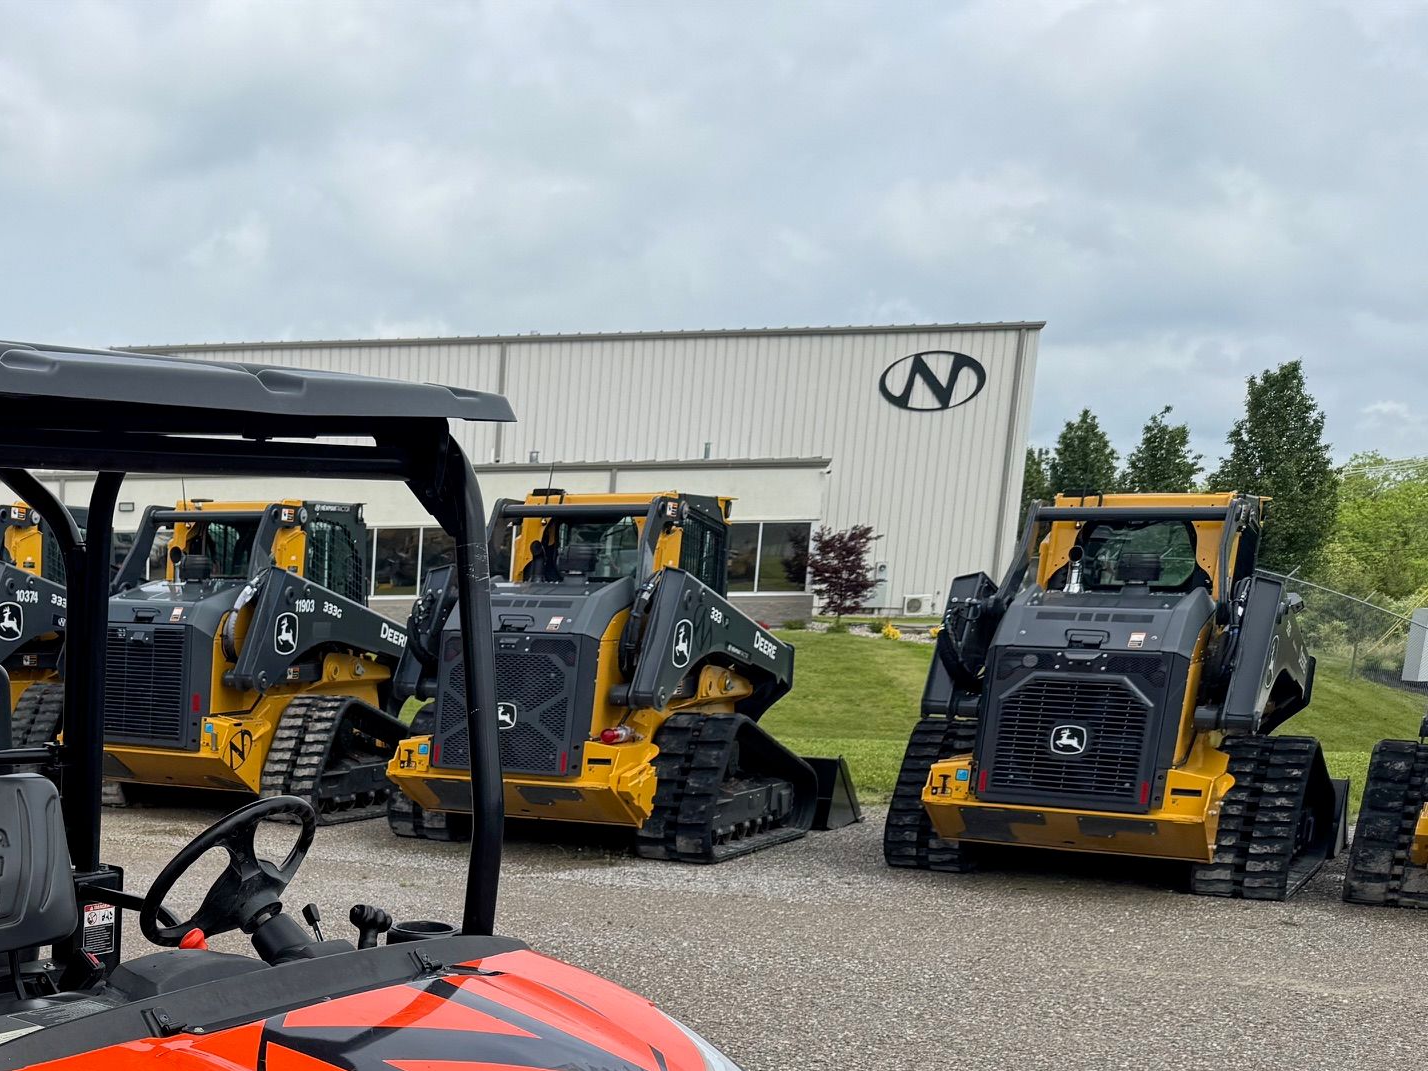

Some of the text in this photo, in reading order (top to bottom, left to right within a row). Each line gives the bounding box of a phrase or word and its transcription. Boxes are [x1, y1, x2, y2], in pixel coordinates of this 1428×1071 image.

[15, 589, 39, 604] 10374
[294, 599, 315, 613] 11903
[322, 601, 343, 619] 333G
[753, 630, 778, 660] DEERE
